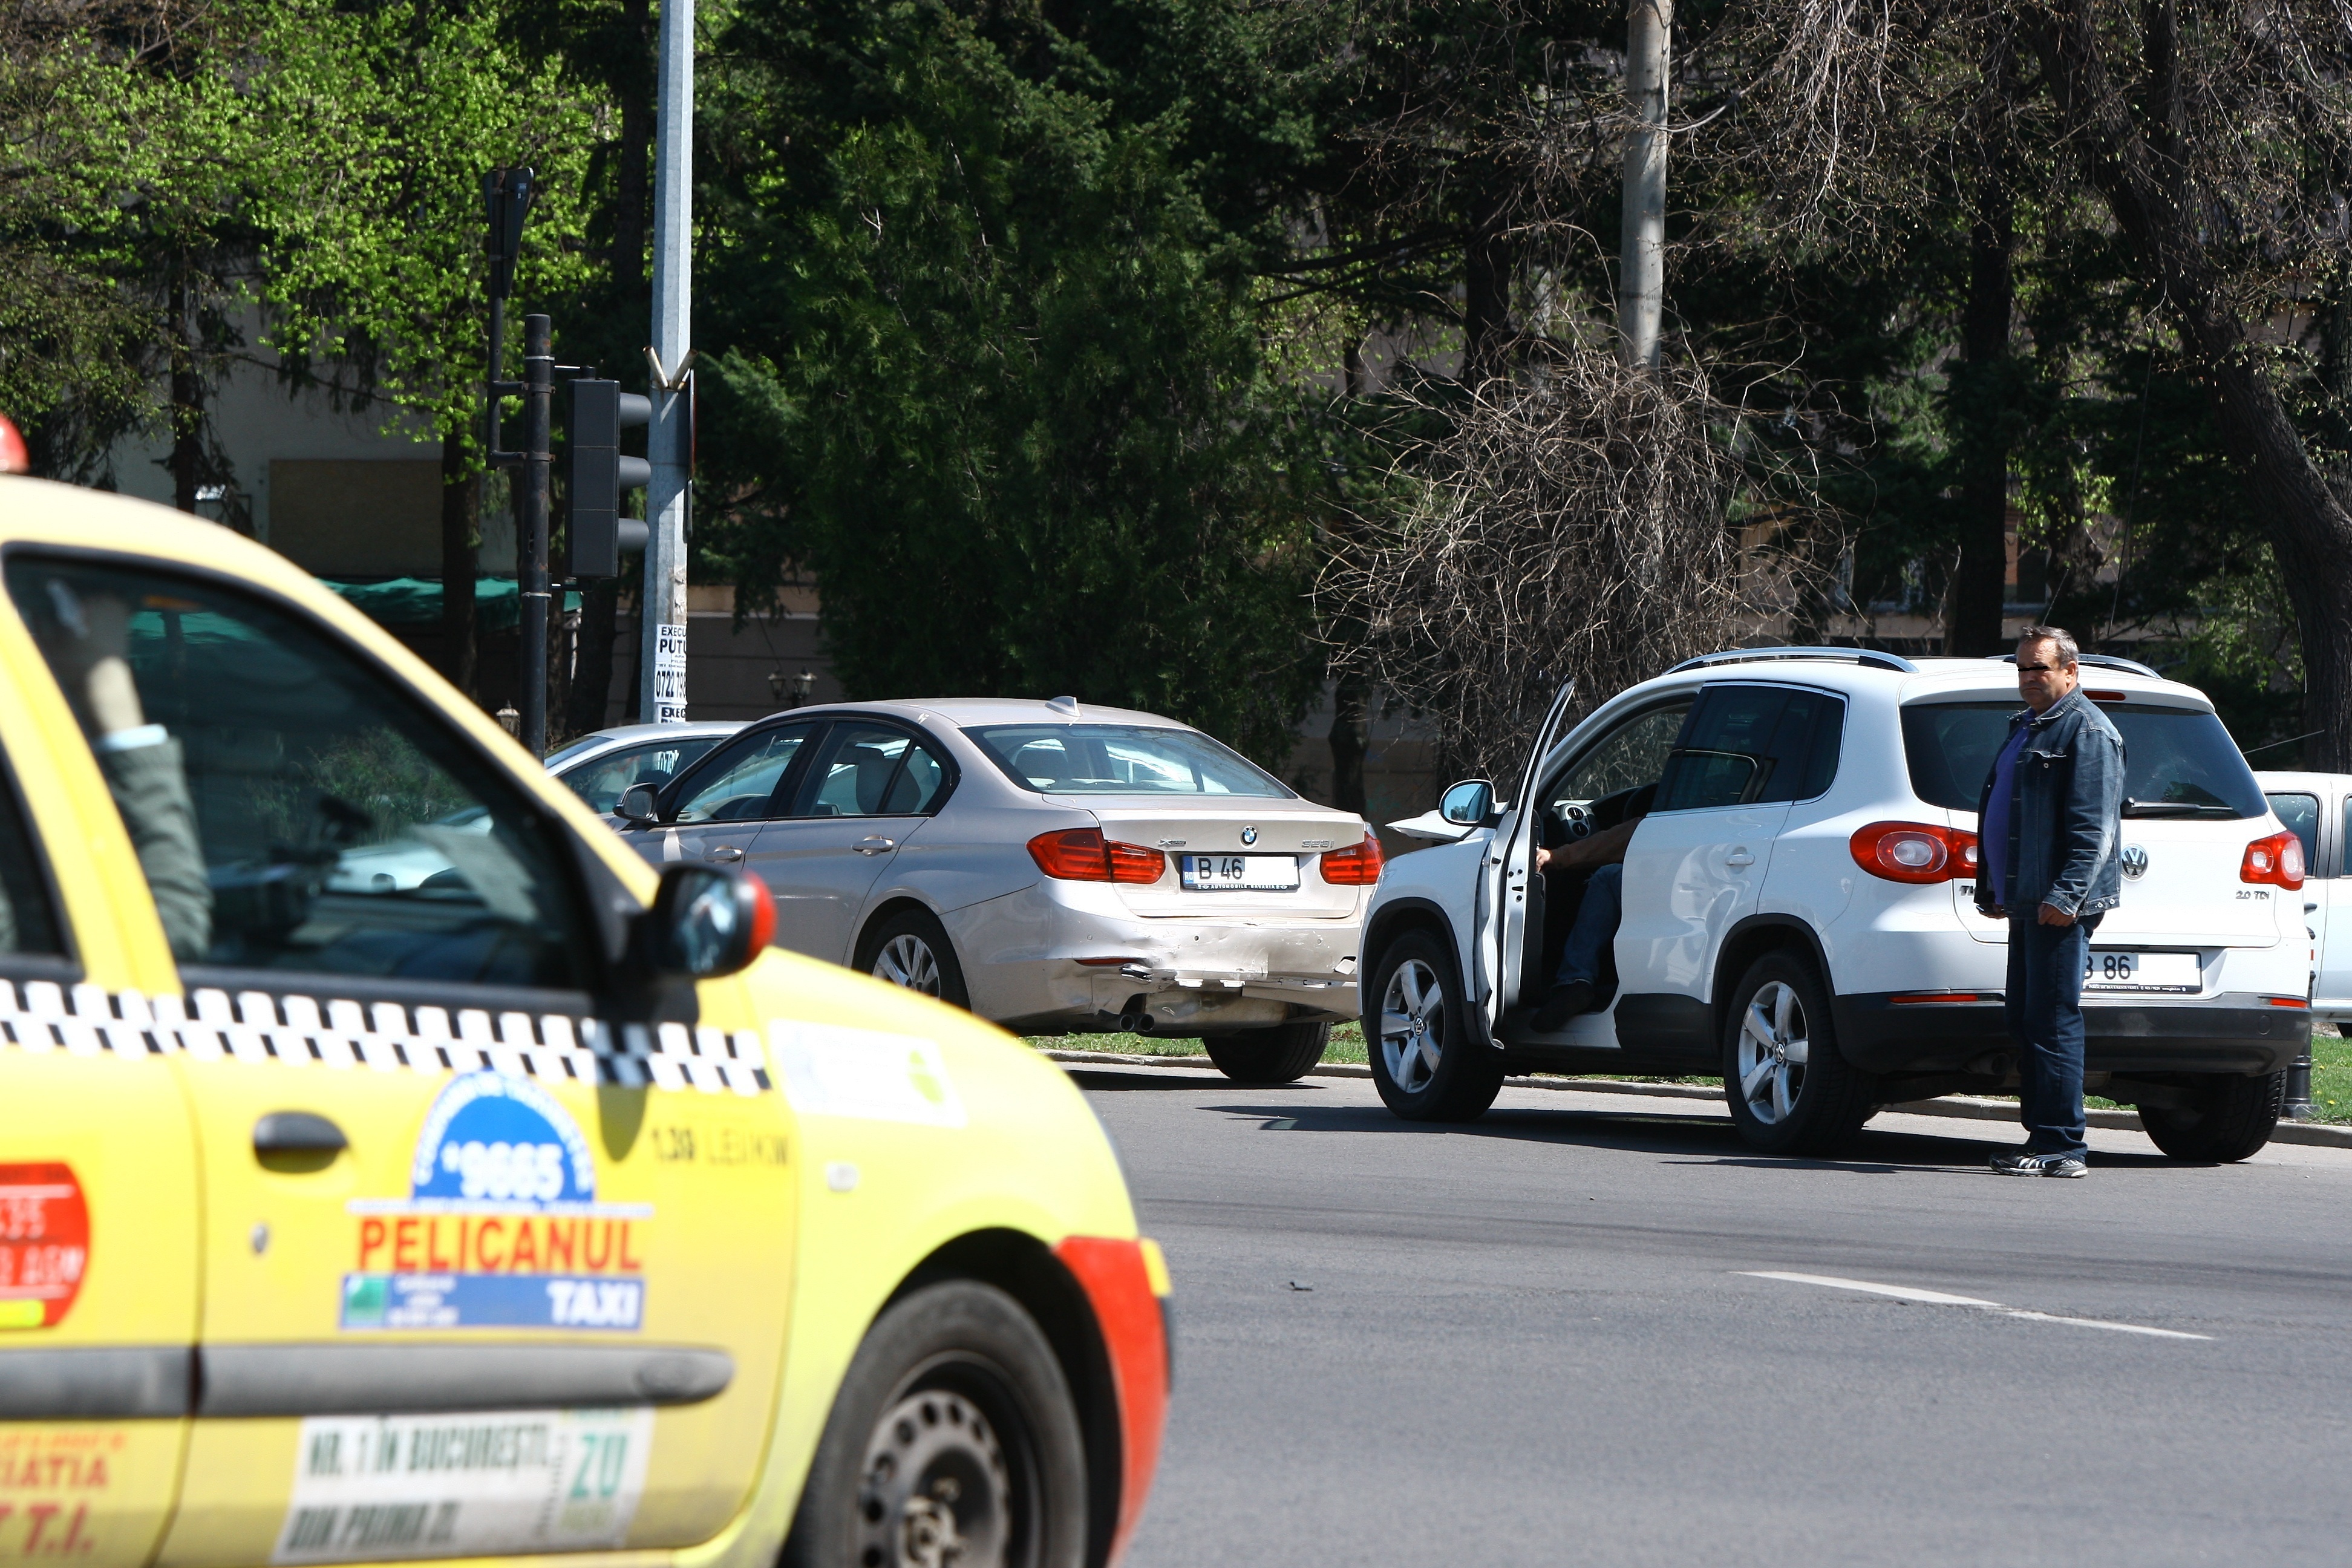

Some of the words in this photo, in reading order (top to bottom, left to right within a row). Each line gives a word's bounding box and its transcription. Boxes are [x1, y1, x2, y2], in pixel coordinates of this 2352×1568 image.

[656, 670, 675, 697] 0722
[1184, 871, 1194, 881] RO
[1198, 857, 1212, 880] B
[1220, 857, 1243, 880] 46
[2103, 955, 2131, 980] 86
[358, 1215, 641, 1275] PELICANUL
[547, 1279, 640, 1325] TAXI
[569, 1432, 631, 1500] ZU
